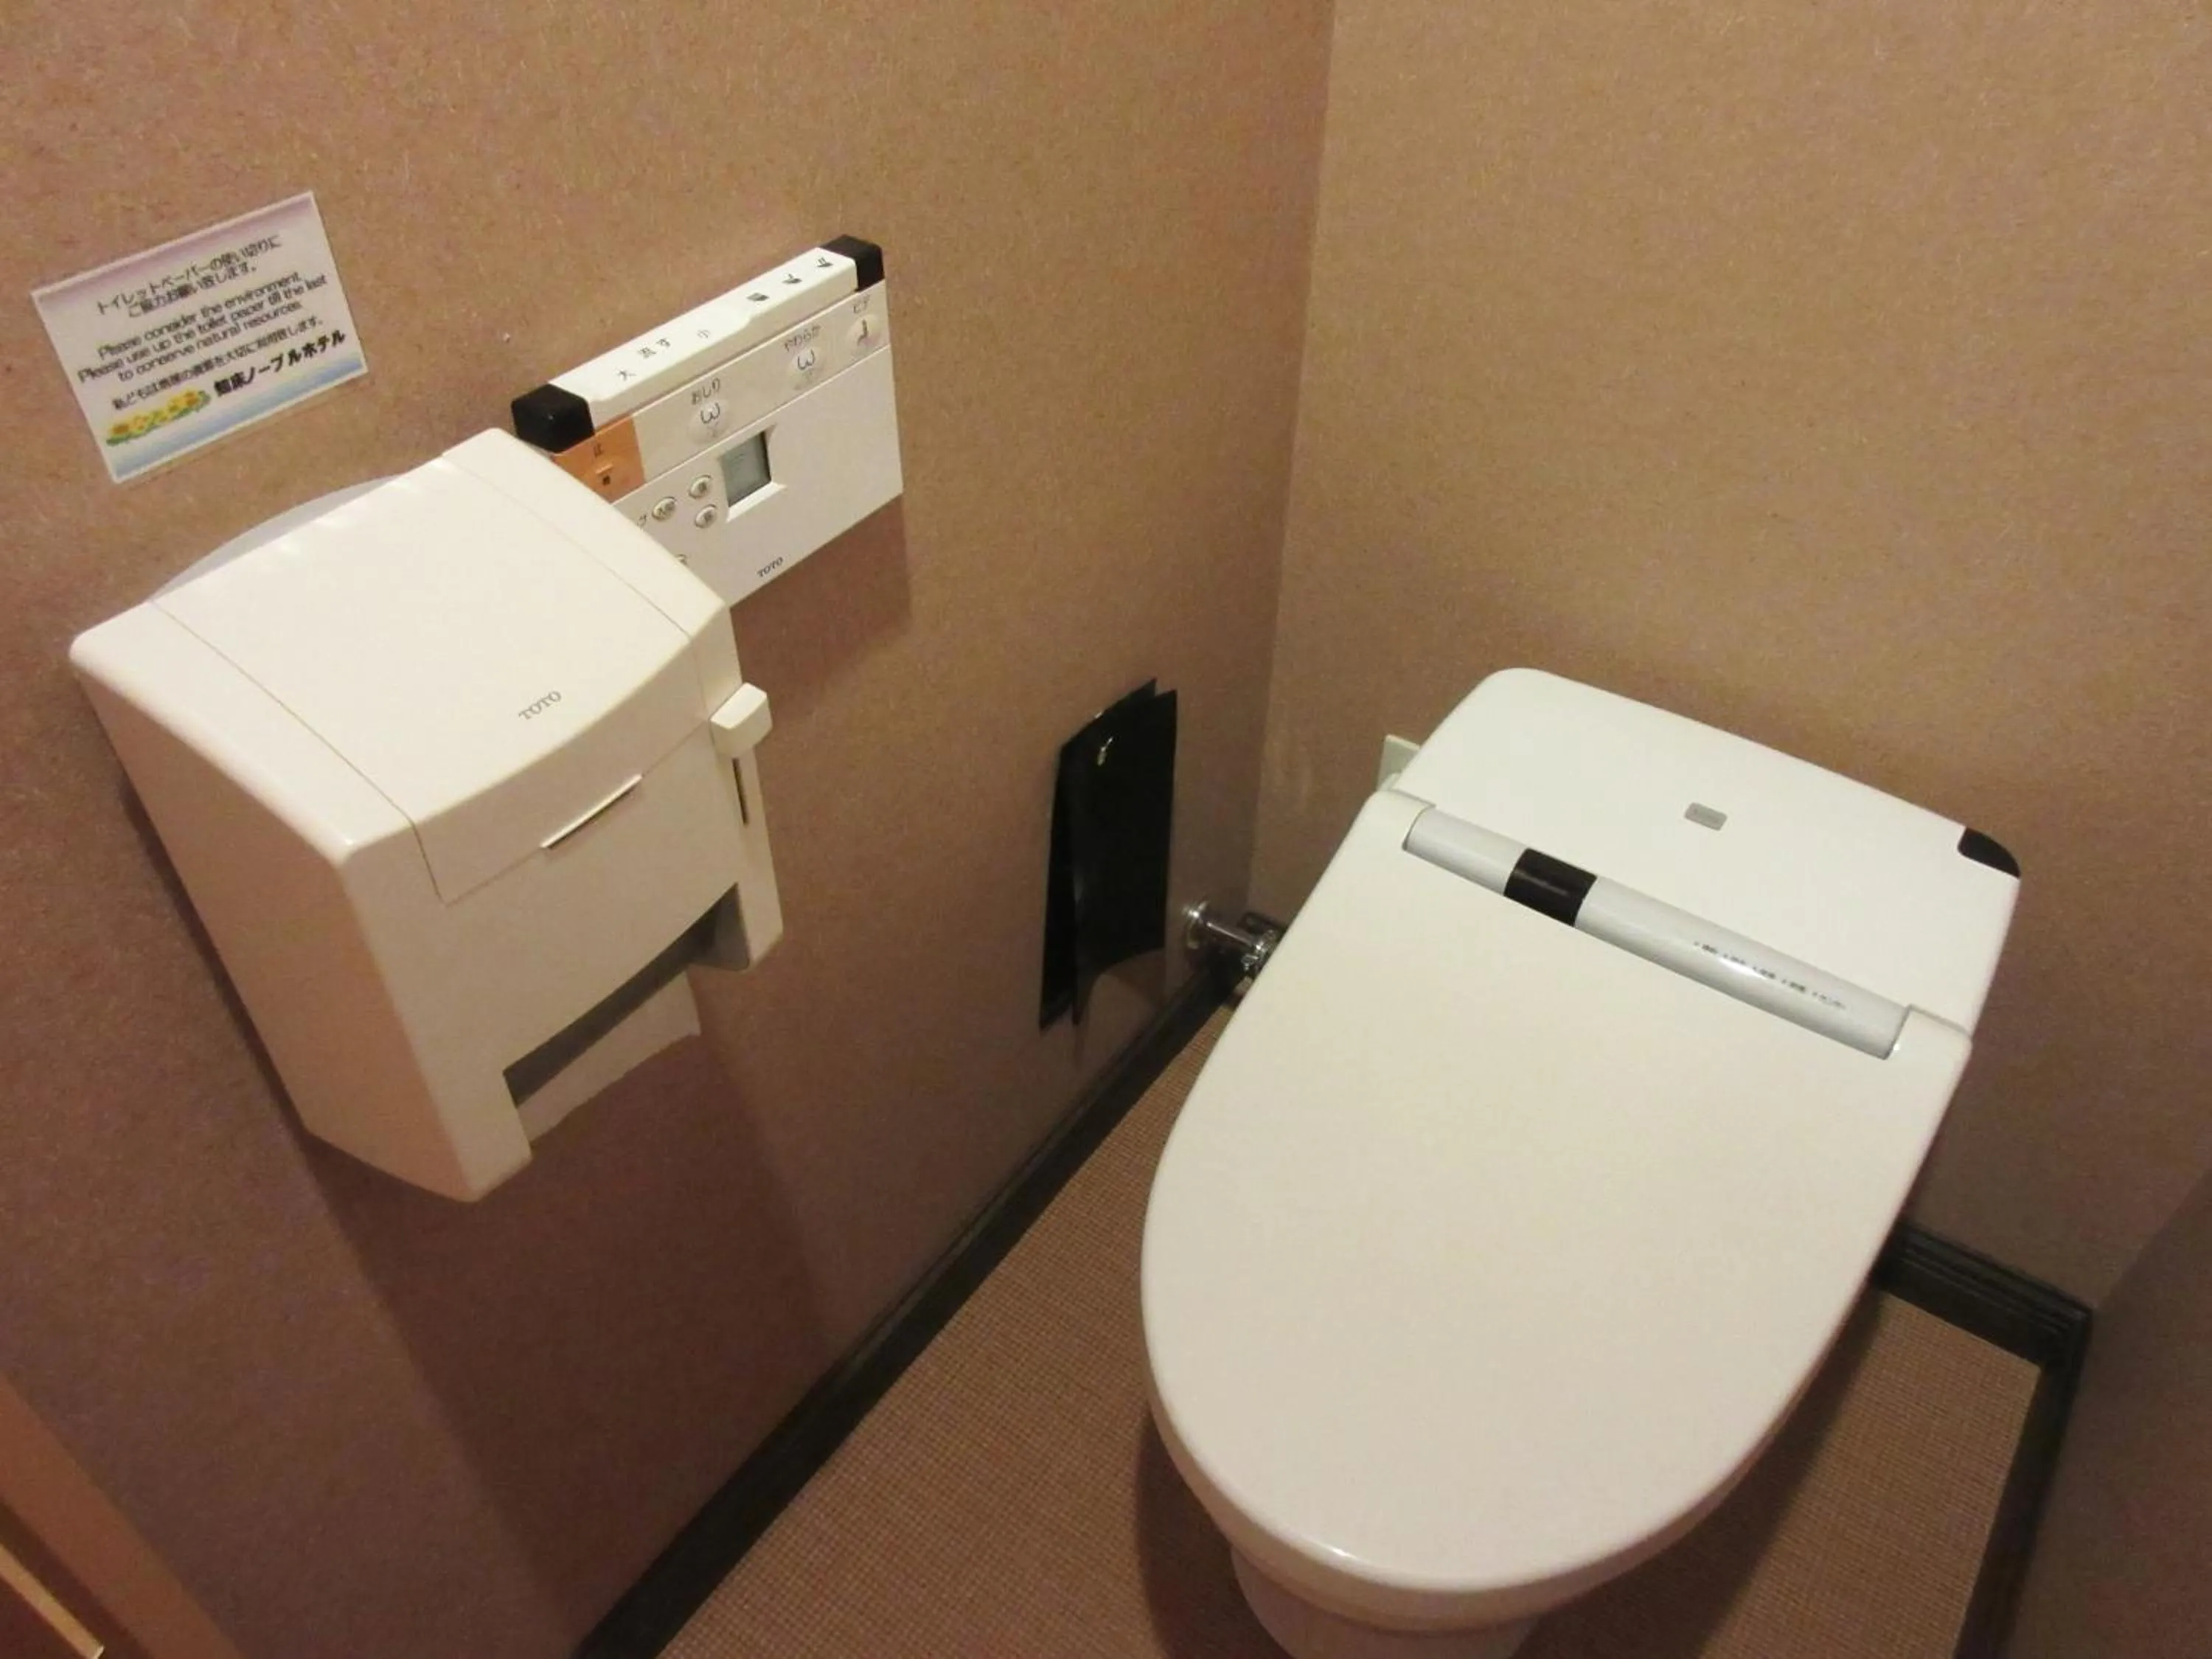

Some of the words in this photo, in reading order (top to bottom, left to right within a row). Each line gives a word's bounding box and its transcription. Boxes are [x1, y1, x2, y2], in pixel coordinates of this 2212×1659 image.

[77, 358, 125, 383] Please
[126, 347, 150, 364] use
[153, 339, 172, 353] up
[173, 329, 196, 344] the
[196, 314, 229, 335] toilet
[283, 285, 305, 299] the
[305, 274, 327, 291] last
[97, 337, 142, 359] Please
[144, 313, 197, 341] consider
[201, 304, 223, 319] the
[118, 369, 133, 382] to
[136, 344, 195, 375] conserve
[196, 321, 241, 349] natural
[757, 556, 784, 578] TOTO
[518, 690, 562, 720] TOTO
